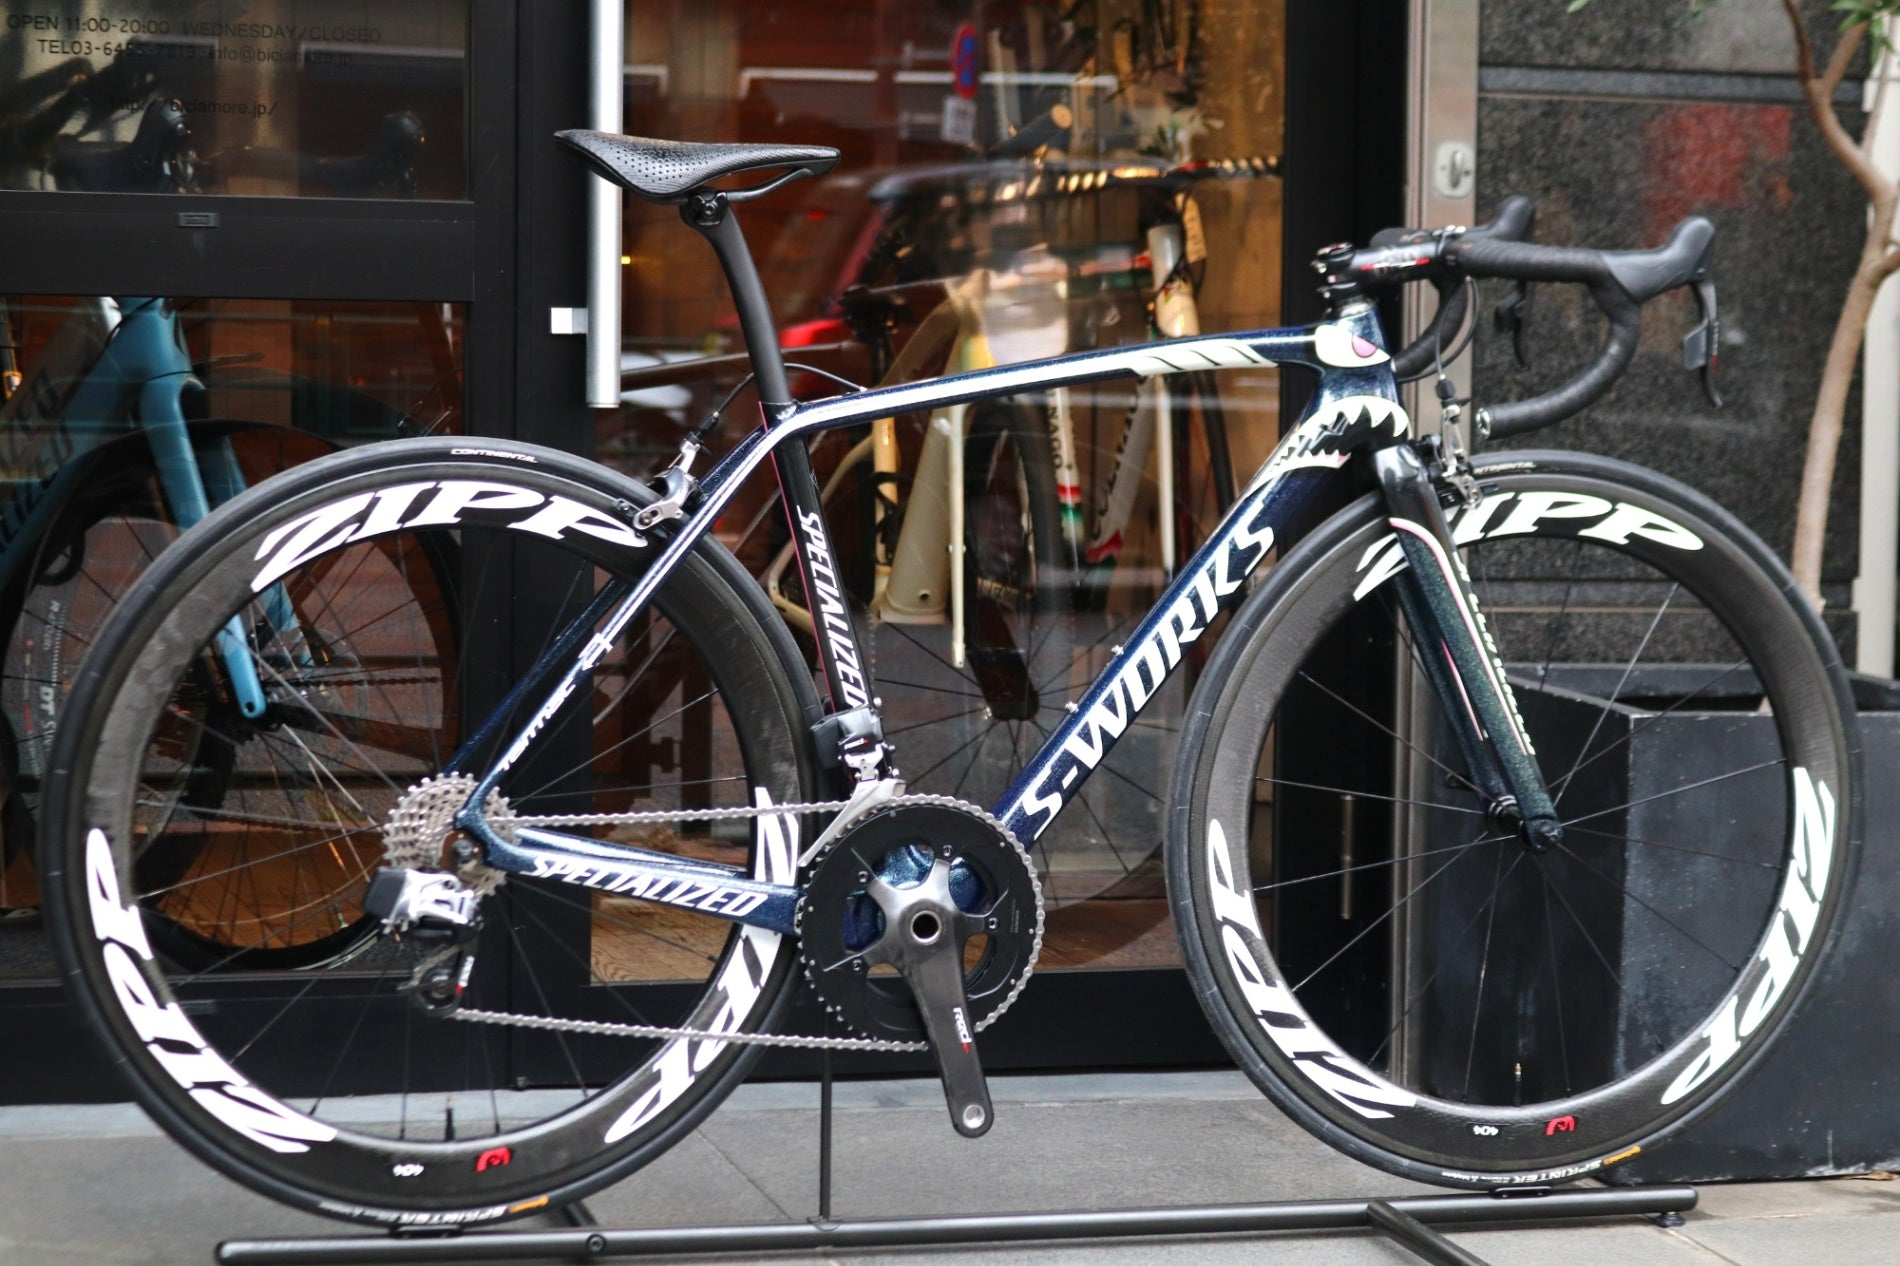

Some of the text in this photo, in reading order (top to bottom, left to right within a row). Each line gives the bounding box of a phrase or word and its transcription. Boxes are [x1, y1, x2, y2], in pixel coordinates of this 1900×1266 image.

[7, 16, 382, 42] OPEN 11:00-20:00 WEDNESDAY/CLOSED
[451, 448, 538, 463] CONTINENTAL
[251, 480, 648, 592] ZIPP
[1353, 490, 1705, 601] ZIPP
[795, 505, 874, 709] SPECIALIZED
[1021, 496, 1275, 841] S-WORKS
[519, 855, 769, 918] SPECIALIZED
[1660, 766, 1836, 1105] ZIPP
[86, 828, 339, 1153] ZIPP
[604, 787, 799, 1144] ZIPP
[1208, 818, 1418, 1120] ZIPP
[1473, 1125, 1499, 1136] 404
[1511, 1159, 1602, 1183] SPRINTER
